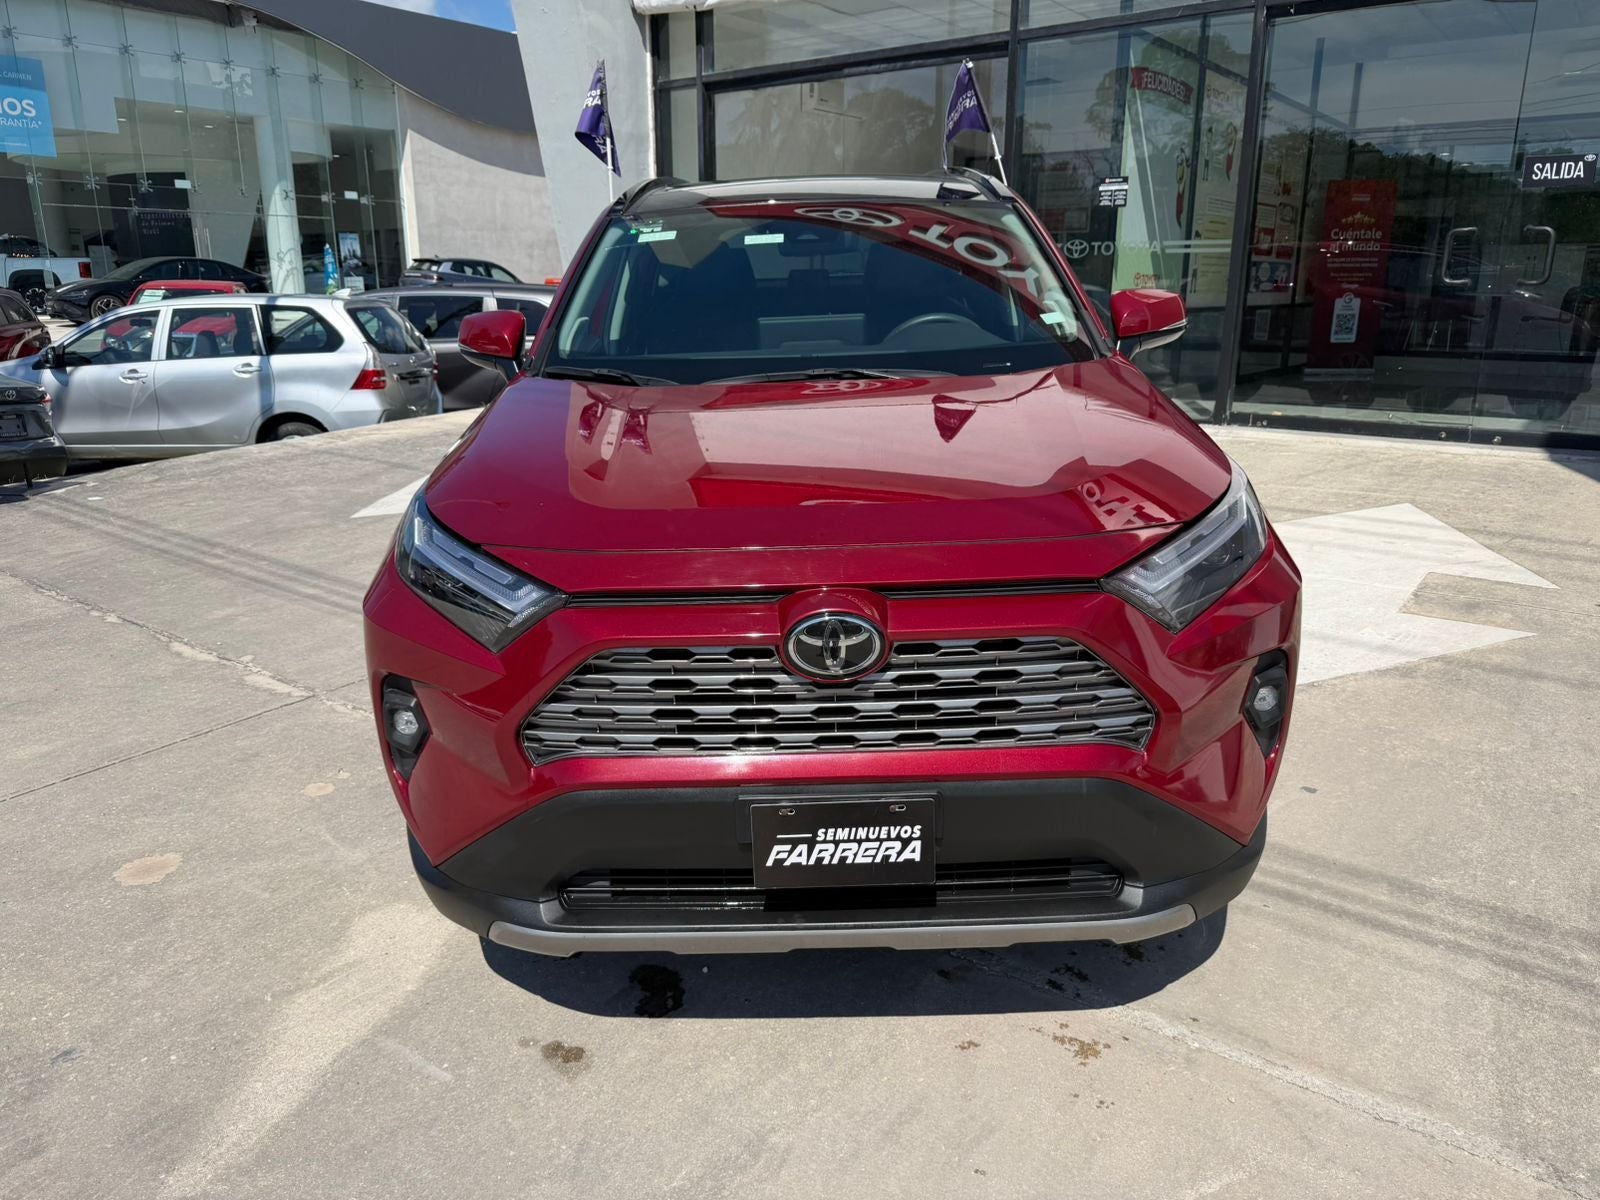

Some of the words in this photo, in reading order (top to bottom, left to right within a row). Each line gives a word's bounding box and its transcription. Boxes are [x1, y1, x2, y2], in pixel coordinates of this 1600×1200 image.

[1532, 161, 1584, 180] SALIDA
[1331, 228, 1383, 240] Cuéntale
[1341, 241, 1381, 252] mundo
[816, 825, 922, 841] SEMINUEVOS
[766, 840, 922, 867] FARRERA
